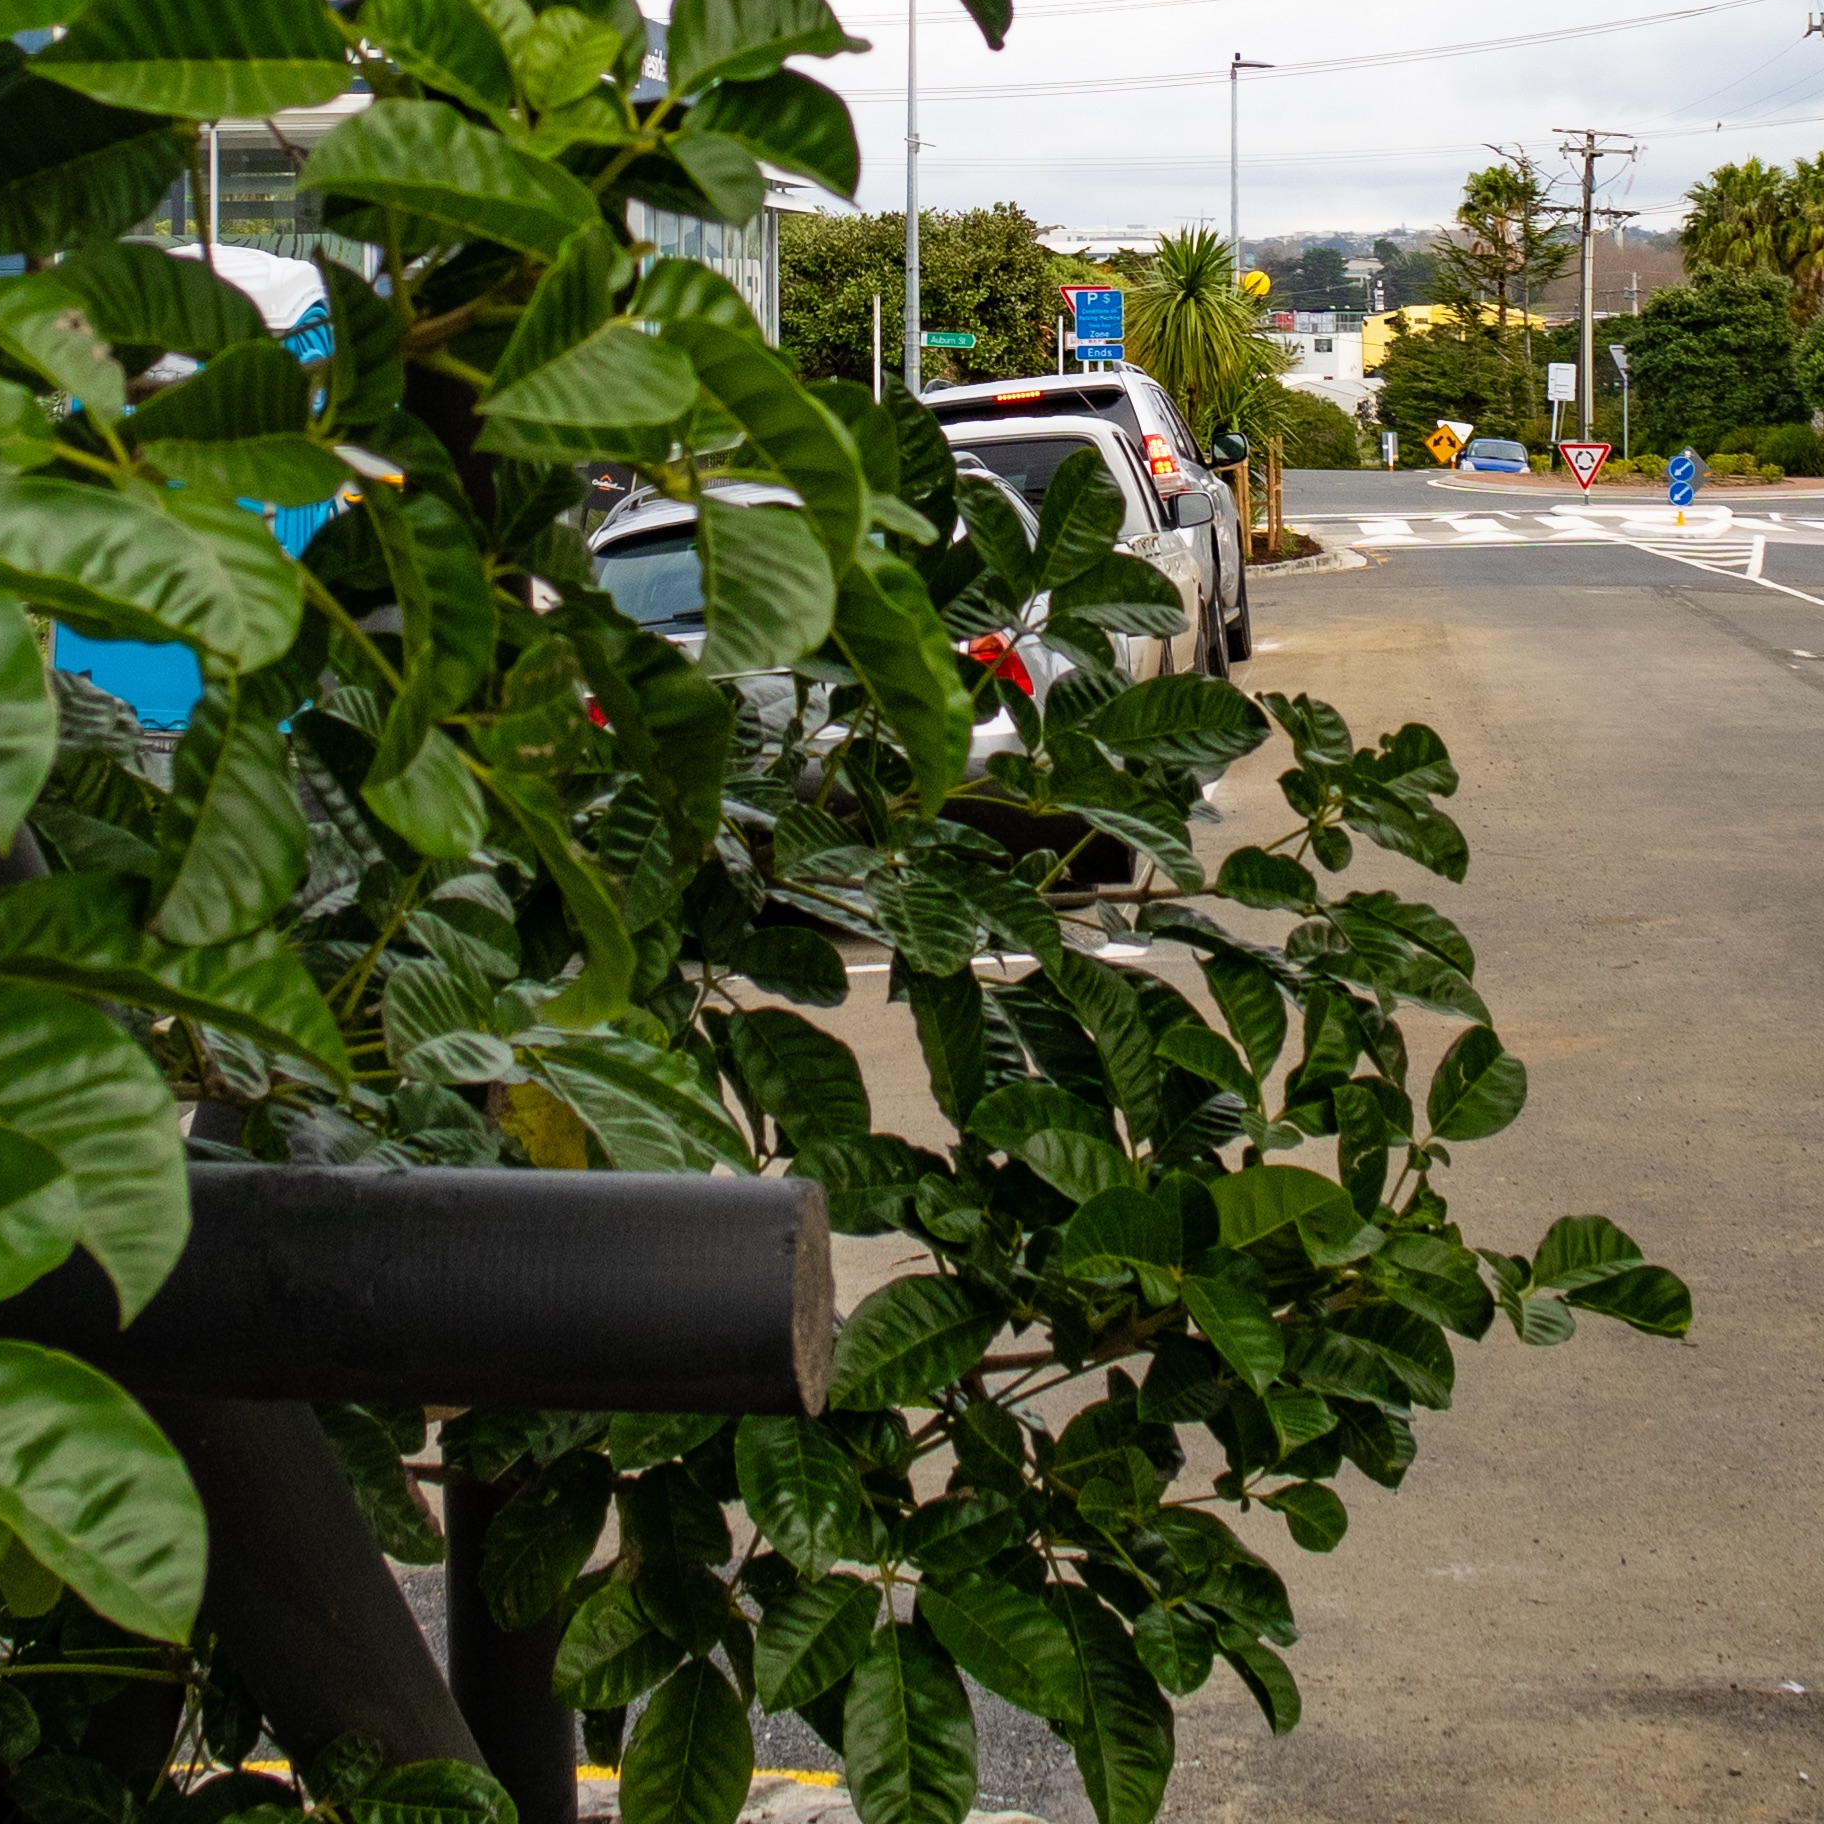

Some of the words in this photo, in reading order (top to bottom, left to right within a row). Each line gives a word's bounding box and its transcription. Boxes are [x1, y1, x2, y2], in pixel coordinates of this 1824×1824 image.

[1087, 292, 1098, 305] P
[1089, 330, 1111, 338] Zone
[930, 335, 956, 345] Auburn
[1087, 347, 1113, 357] Ends
